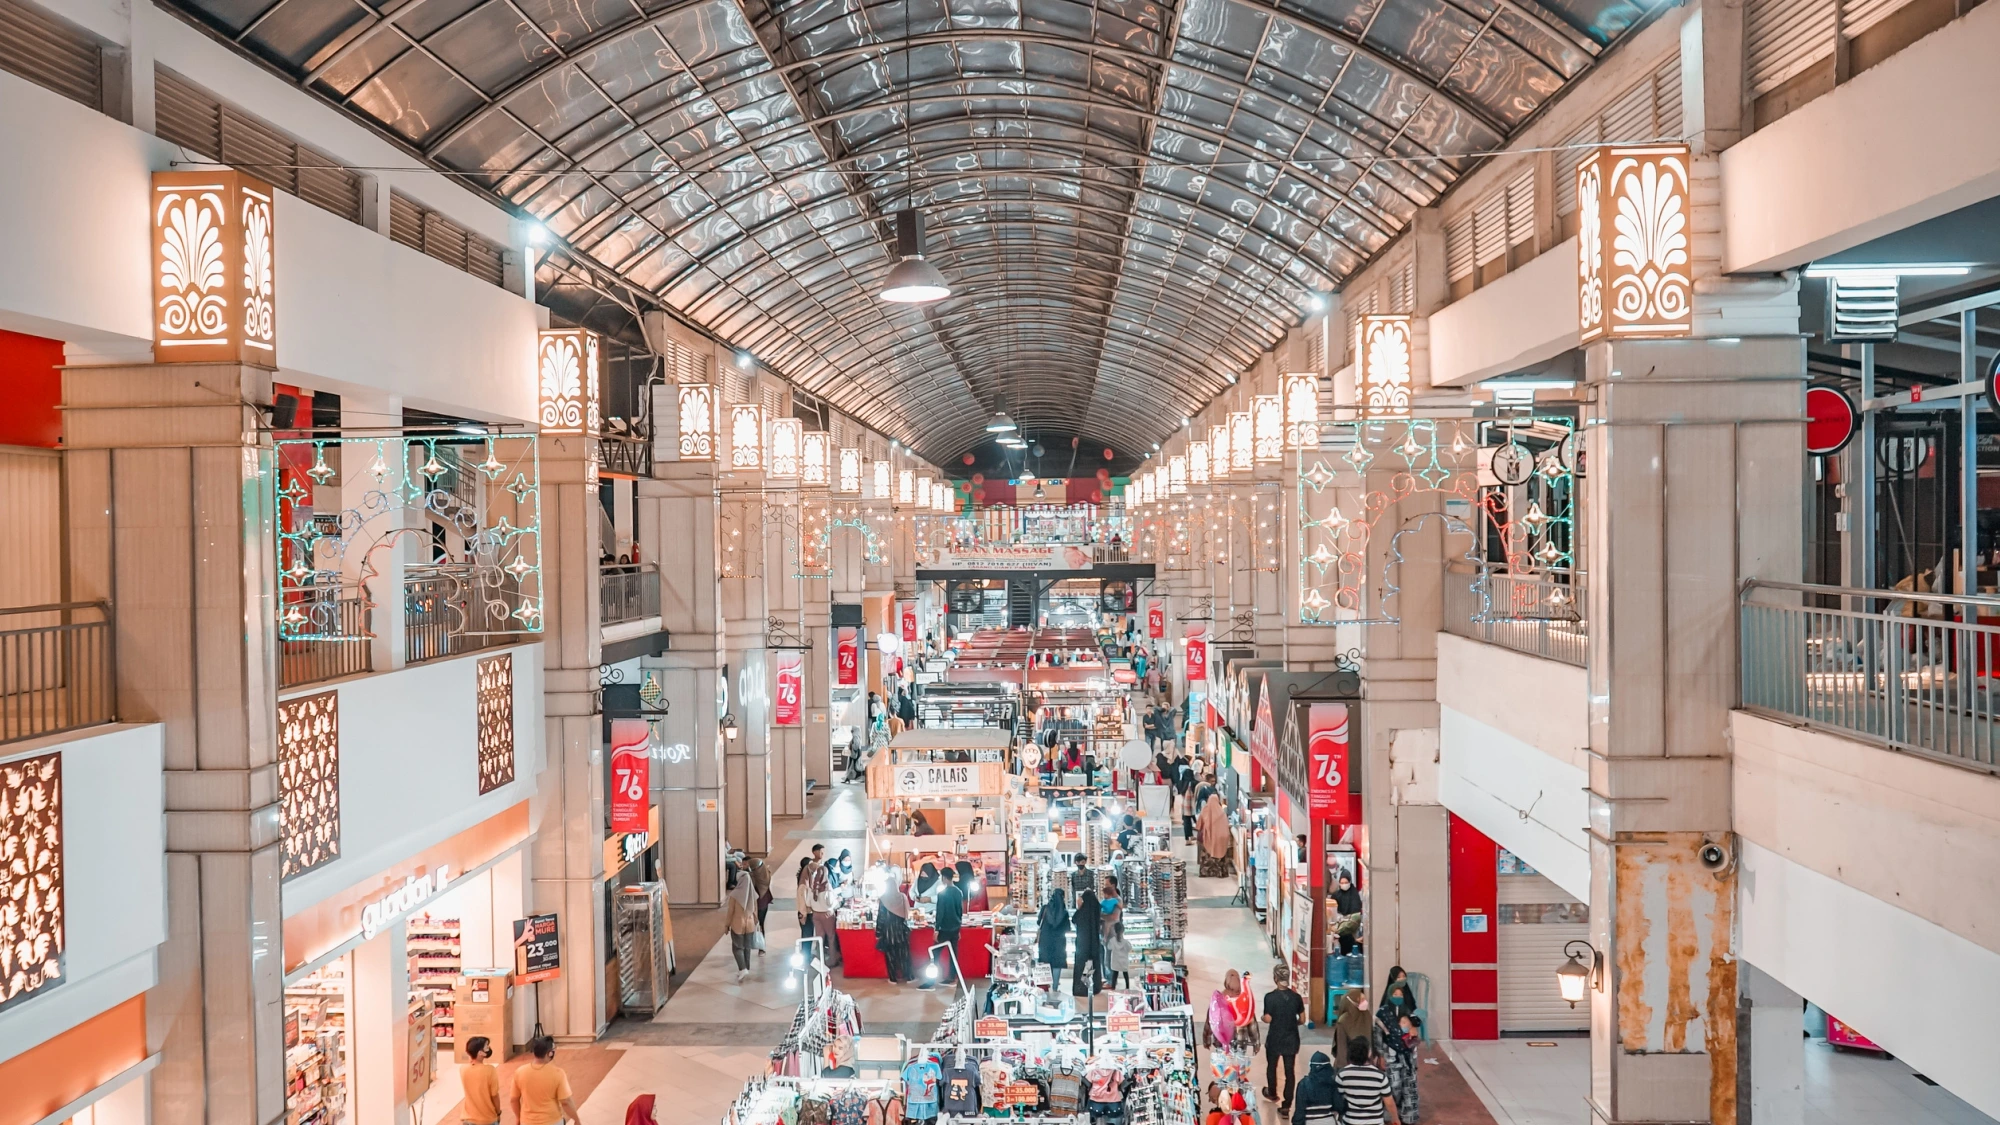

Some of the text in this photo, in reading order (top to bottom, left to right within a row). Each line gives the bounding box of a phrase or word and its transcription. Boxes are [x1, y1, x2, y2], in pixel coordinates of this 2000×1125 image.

[992, 546, 1055, 554] MASSAGE
[903, 618, 915, 631] 76
[1150, 614, 1161, 627] 76
[840, 652, 855, 669] 76
[1188, 647, 1204, 665] 76
[779, 683, 797, 705] 76
[1313, 754, 1342, 787] 76
[615, 768, 643, 801] 76
[525, 972, 552, 983] guardian
